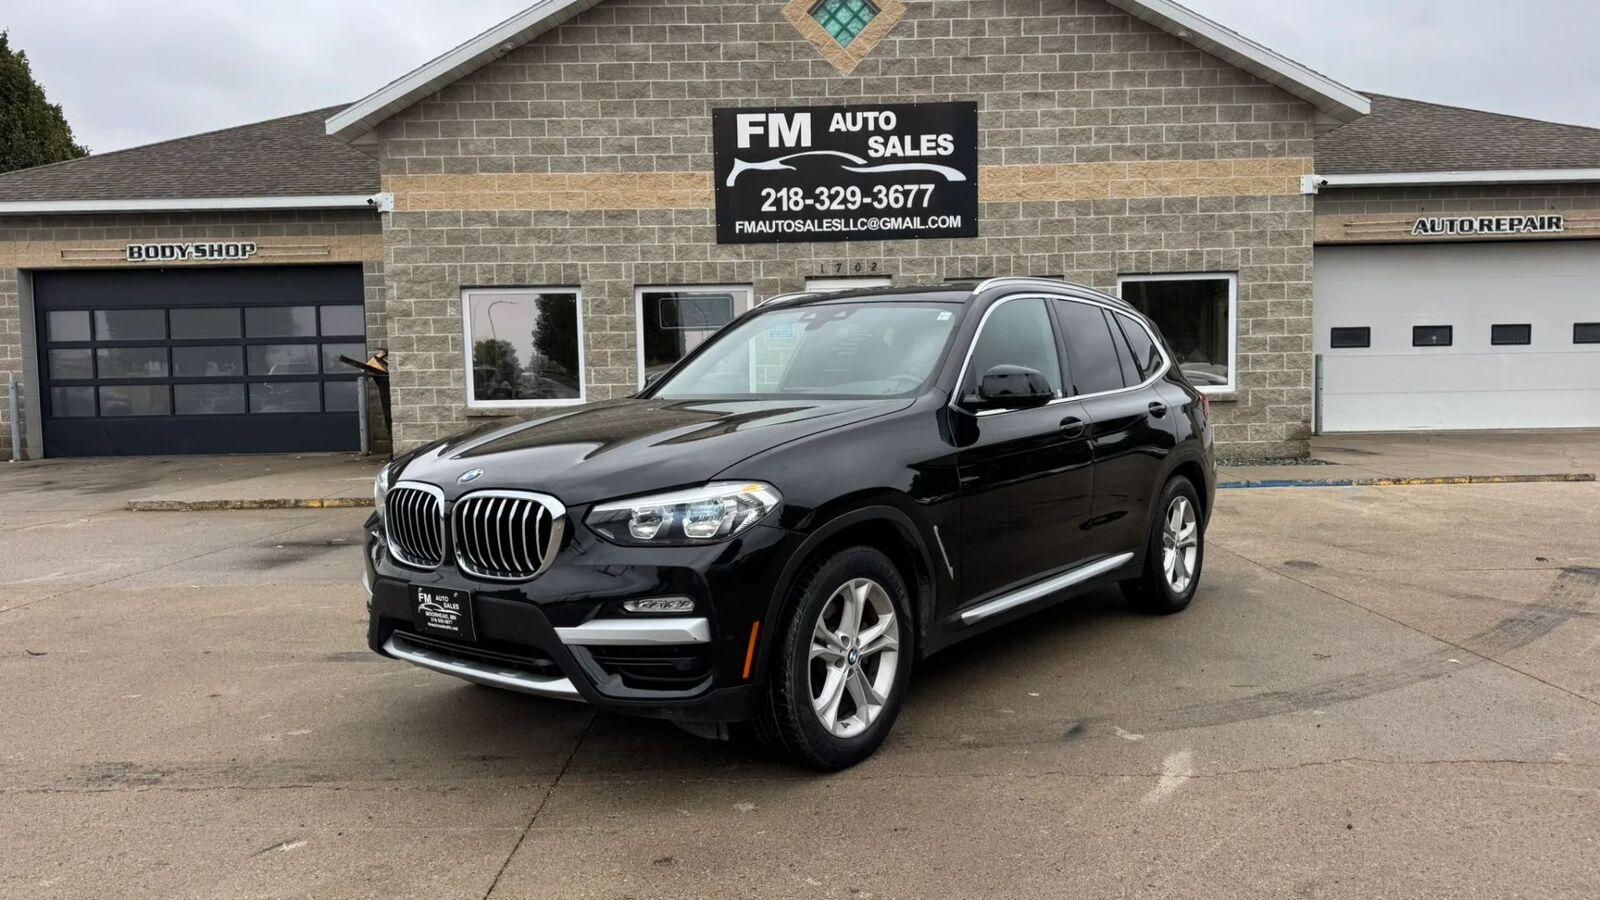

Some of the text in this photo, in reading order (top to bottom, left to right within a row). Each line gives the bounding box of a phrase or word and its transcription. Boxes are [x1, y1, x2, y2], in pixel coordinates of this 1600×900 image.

[736, 111, 897, 149] FM AUTO
[868, 133, 955, 157] SALES
[761, 184, 935, 211] 218-329-3677
[735, 215, 961, 234] FMAUTOSALESLLC@GMAIL.COM
[1413, 215, 1564, 234] AUTO REPAIR
[128, 242, 256, 261] BODY SHOP
[820, 262, 878, 274] 1702
[418, 593, 432, 604] FM
[443, 602, 460, 610] SALES
